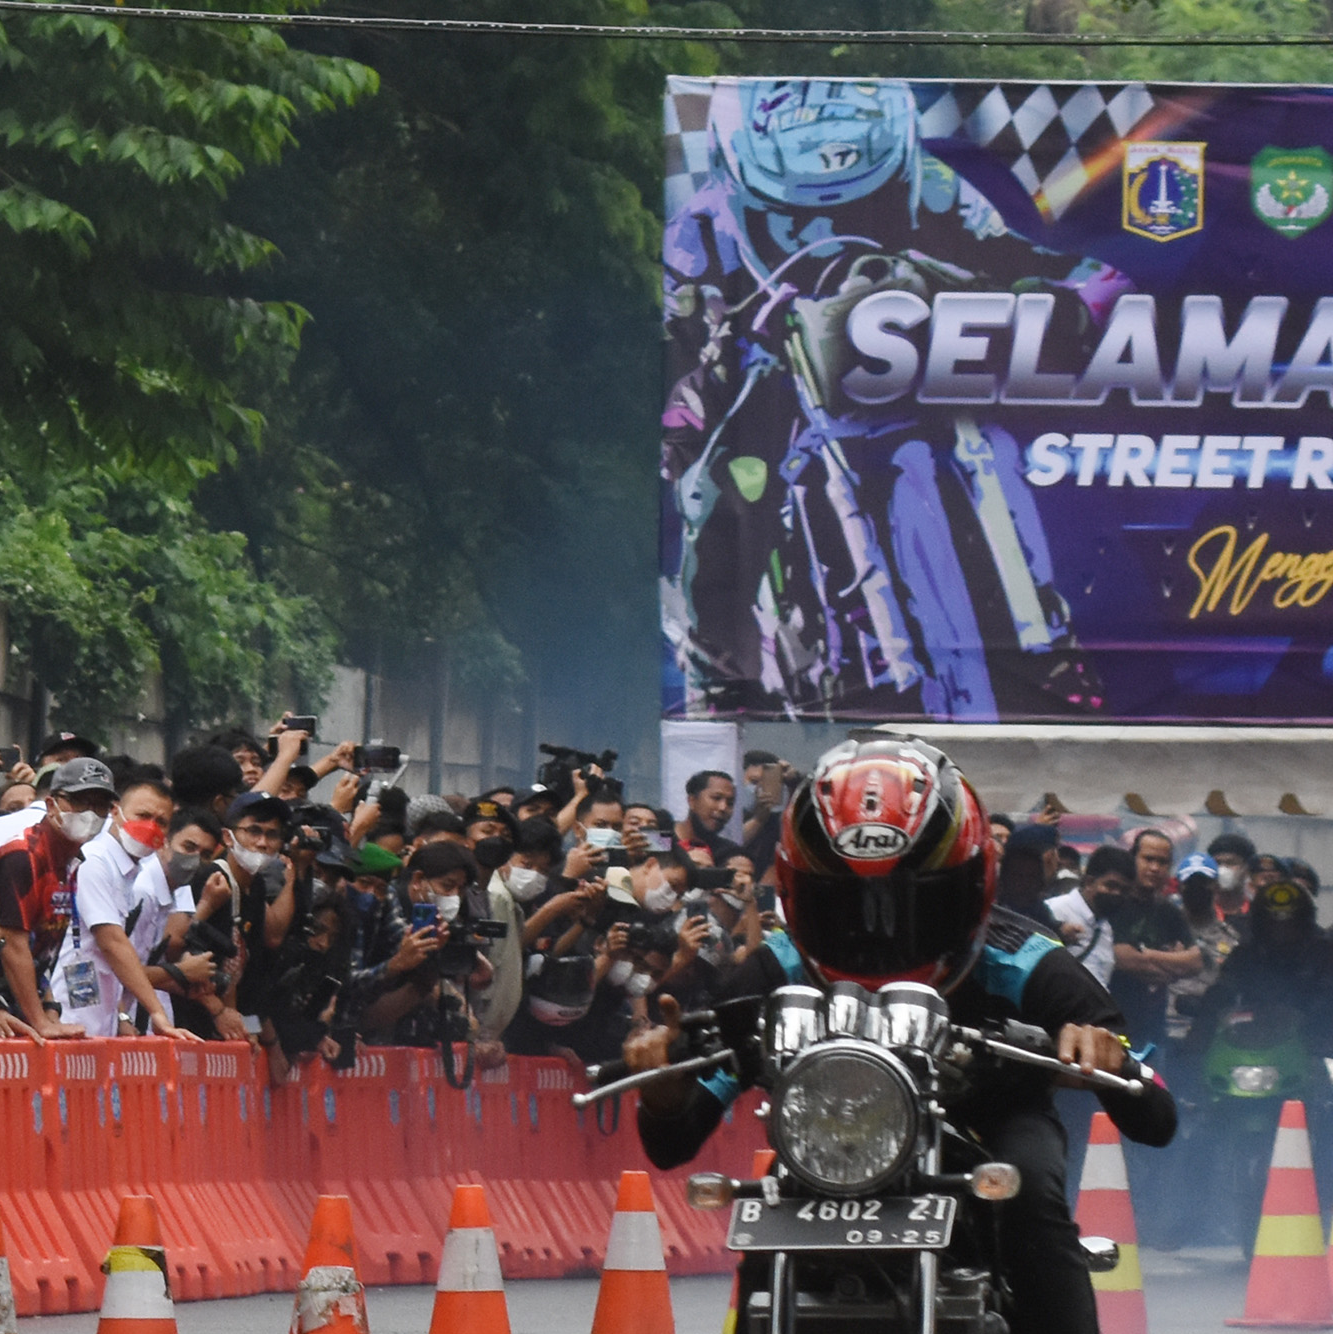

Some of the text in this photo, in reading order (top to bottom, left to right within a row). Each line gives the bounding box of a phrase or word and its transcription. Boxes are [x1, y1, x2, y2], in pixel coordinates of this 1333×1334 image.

[1026, 432, 1284, 488] STREET
[839, 828, 898, 848] Arai
[740, 1201, 763, 1223] B
[796, 1200, 883, 1222] 4602
